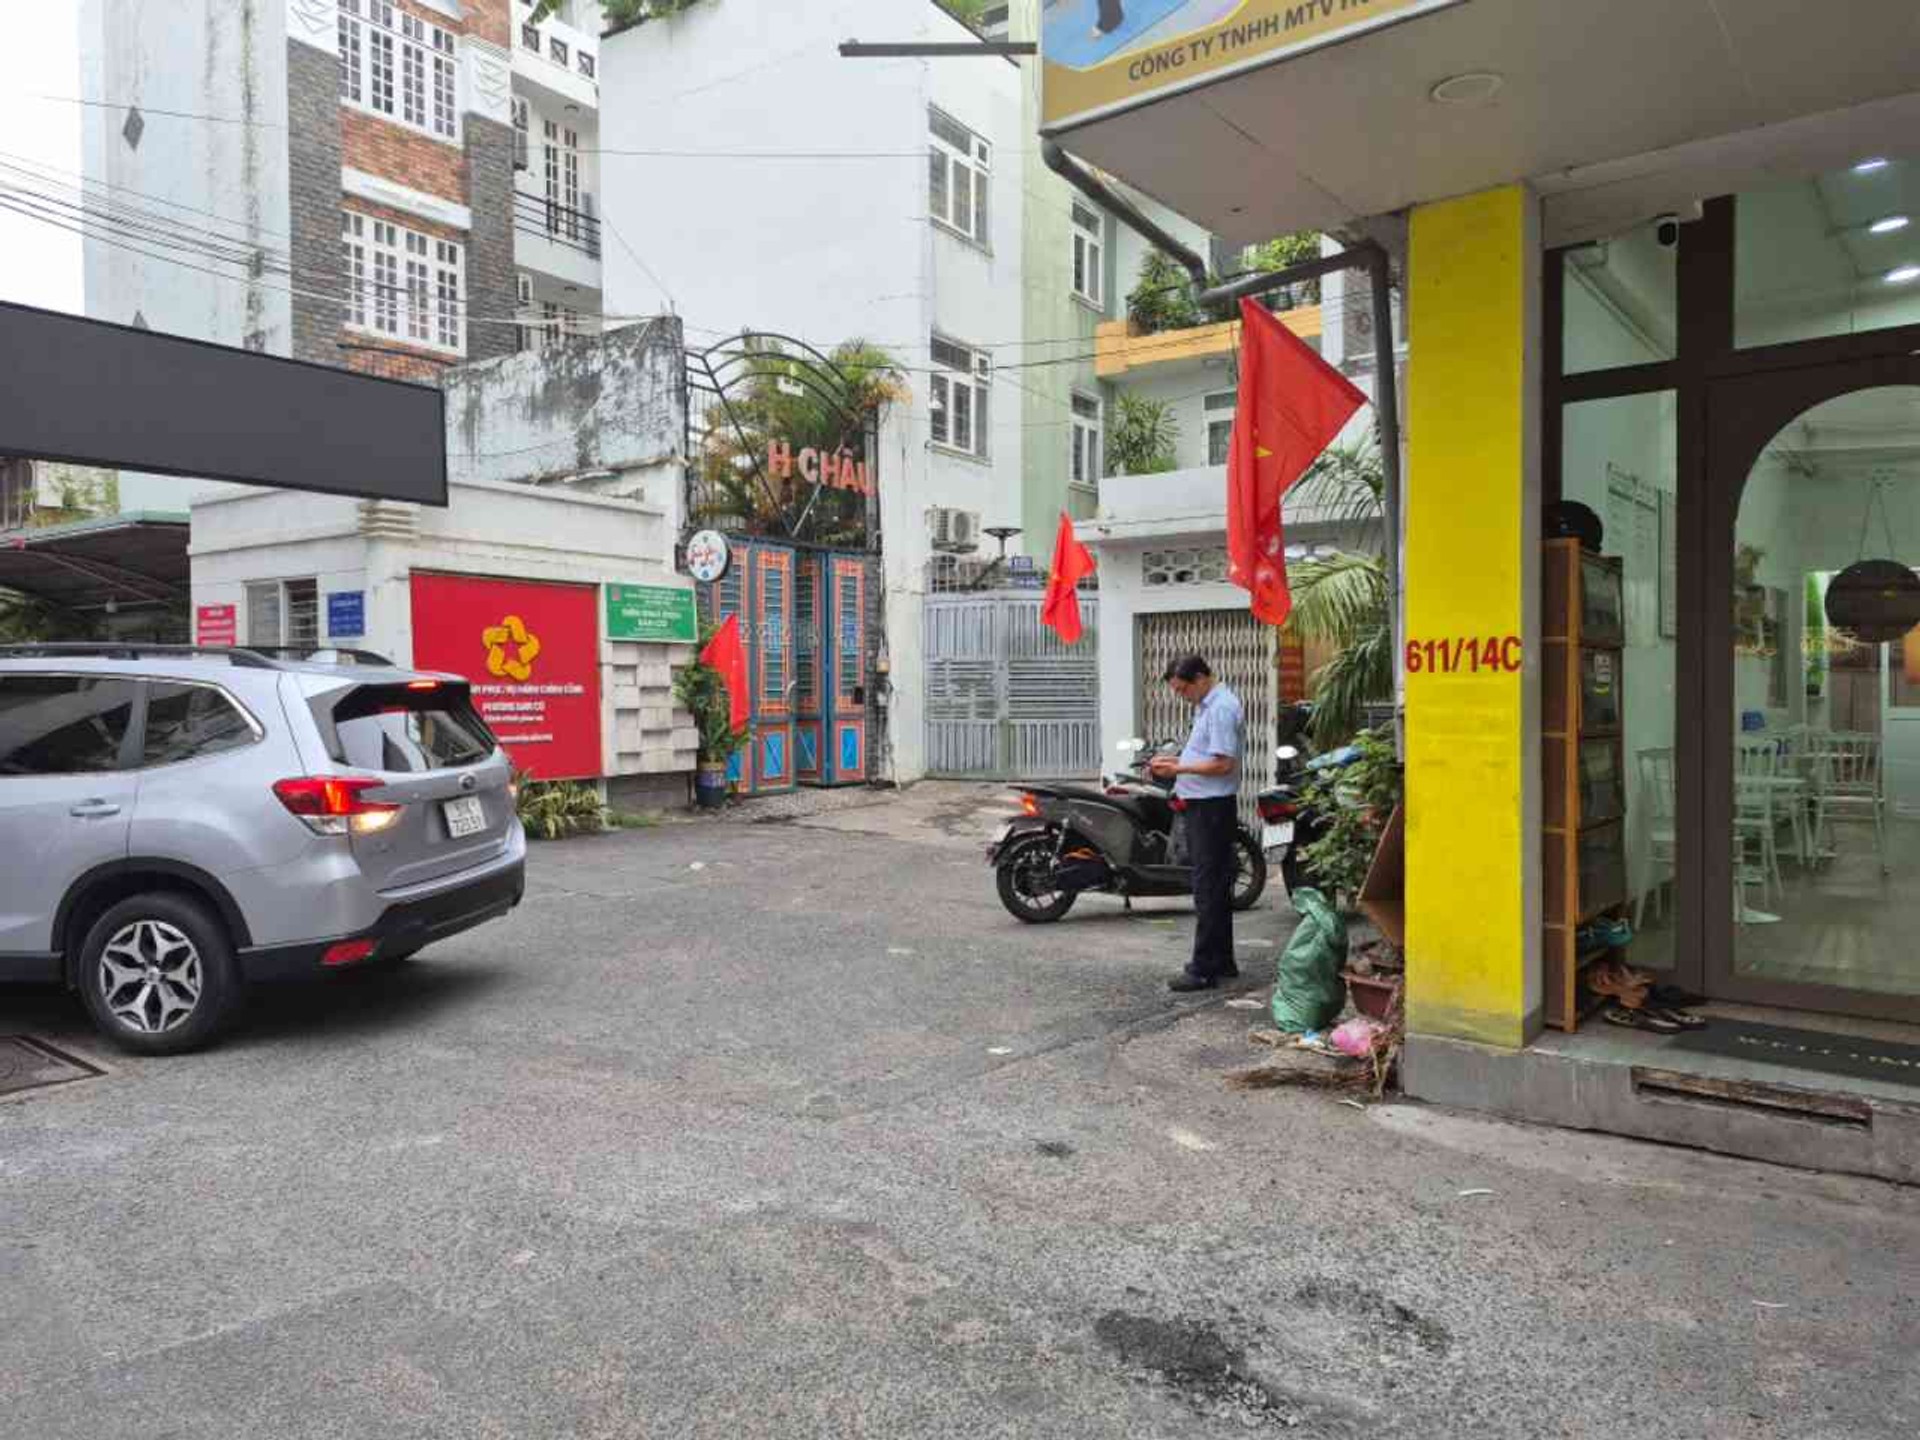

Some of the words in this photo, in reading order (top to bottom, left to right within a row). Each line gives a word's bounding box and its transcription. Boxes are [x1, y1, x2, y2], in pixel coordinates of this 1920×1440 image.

[1128, 46, 1186, 81] CÔNG
[1189, 36, 1214, 61] TY
[1218, 13, 1279, 51] TNHH
[1284, 0, 1334, 31] MTV
[1405, 635, 1523, 673] 611/14C
